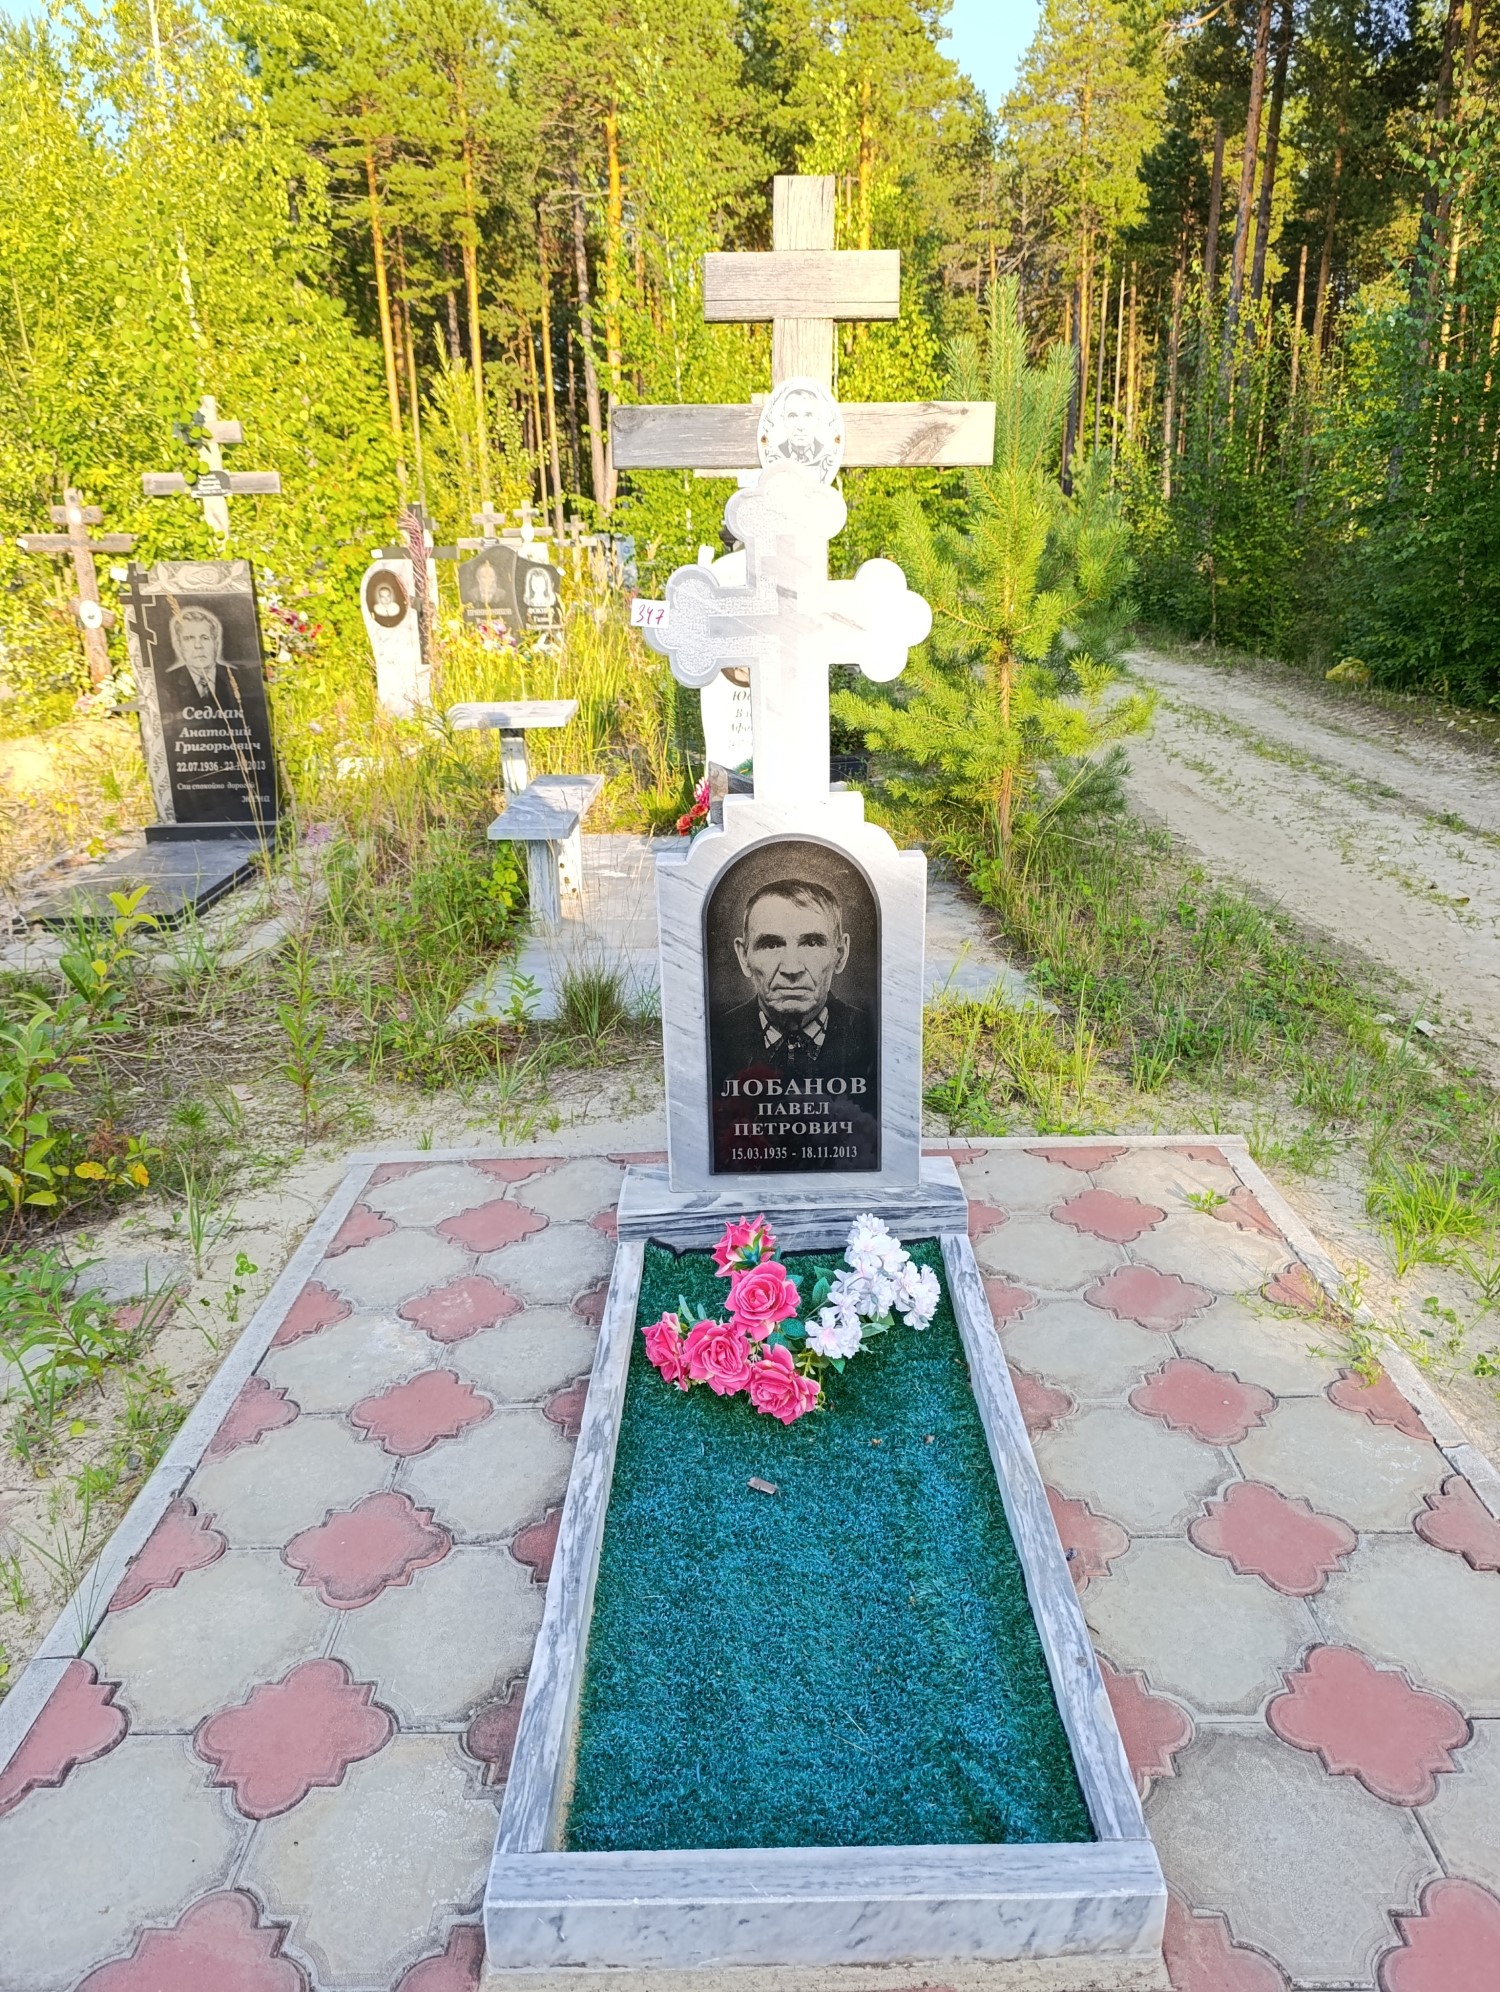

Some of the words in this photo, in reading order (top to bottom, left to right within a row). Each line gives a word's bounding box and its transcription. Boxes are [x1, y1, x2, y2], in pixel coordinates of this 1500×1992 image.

[636, 604, 665, 625] 347
[182, 706, 243, 720] Седлак
[179, 726, 252, 738] Анатолий
[175, 741, 261, 754] Григорьевич
[176, 762, 219, 772] 22.07.1936
[224, 761, 266, 771] 23.12013
[227, 782, 255, 791] дорогй
[720, 1077, 867, 1097] ЛОБАНОВ
[758, 1102, 830, 1116] ПАВЕЛ
[734, 1121, 854, 1136] ПЕТРОВИЧ
[732, 1147, 788, 1160] 15.03.1935
[801, 1146, 858, 1159] 18.11.2013
